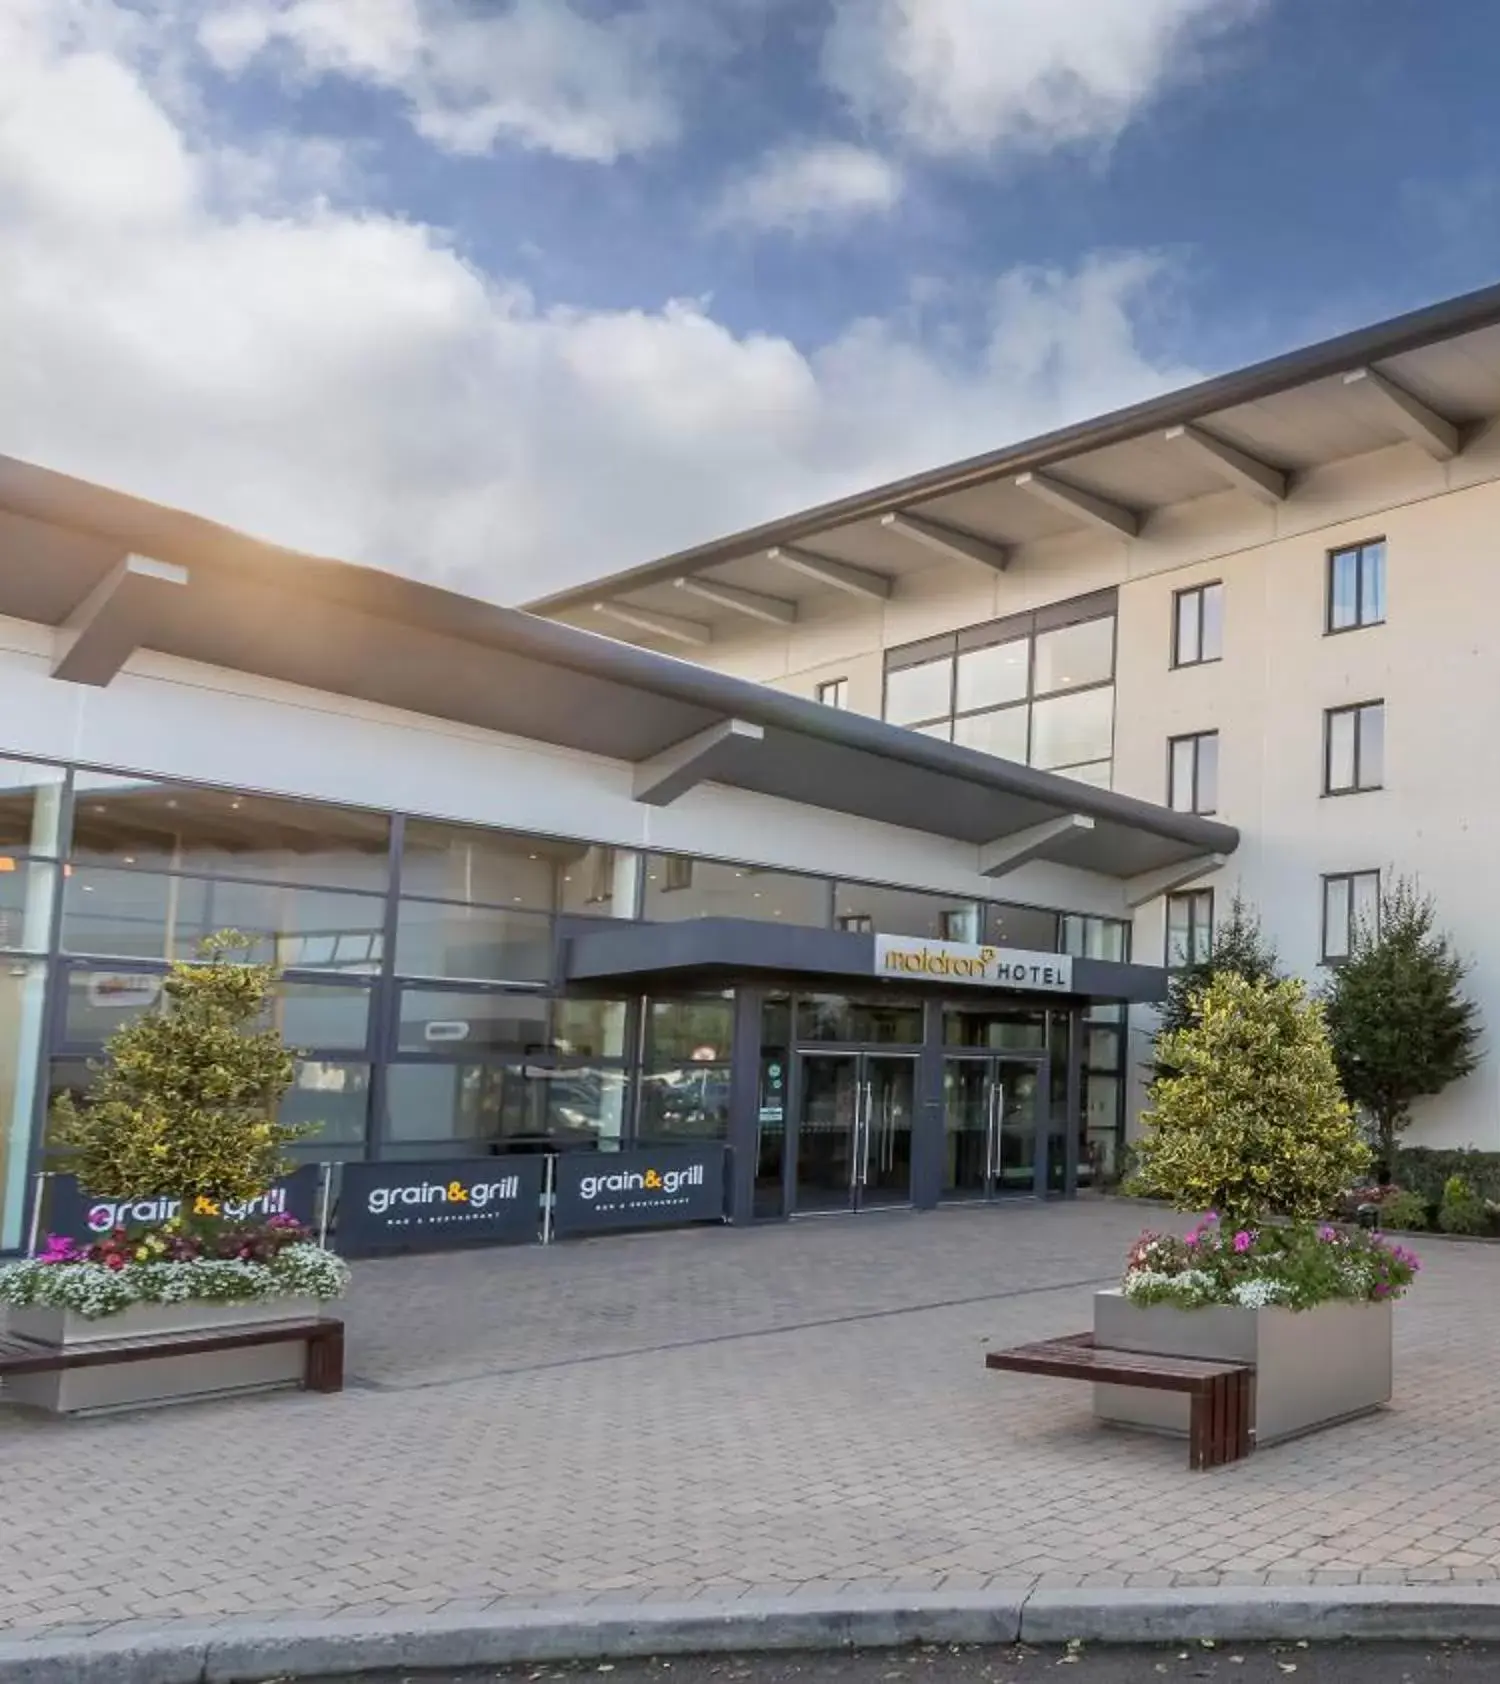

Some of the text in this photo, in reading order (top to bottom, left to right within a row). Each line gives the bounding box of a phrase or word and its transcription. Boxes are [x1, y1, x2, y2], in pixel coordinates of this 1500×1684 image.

[884, 947, 1066, 986] maldron HOTEL
[367, 1175, 520, 1214] grain&grill
[580, 1165, 704, 1200] grain&grill
